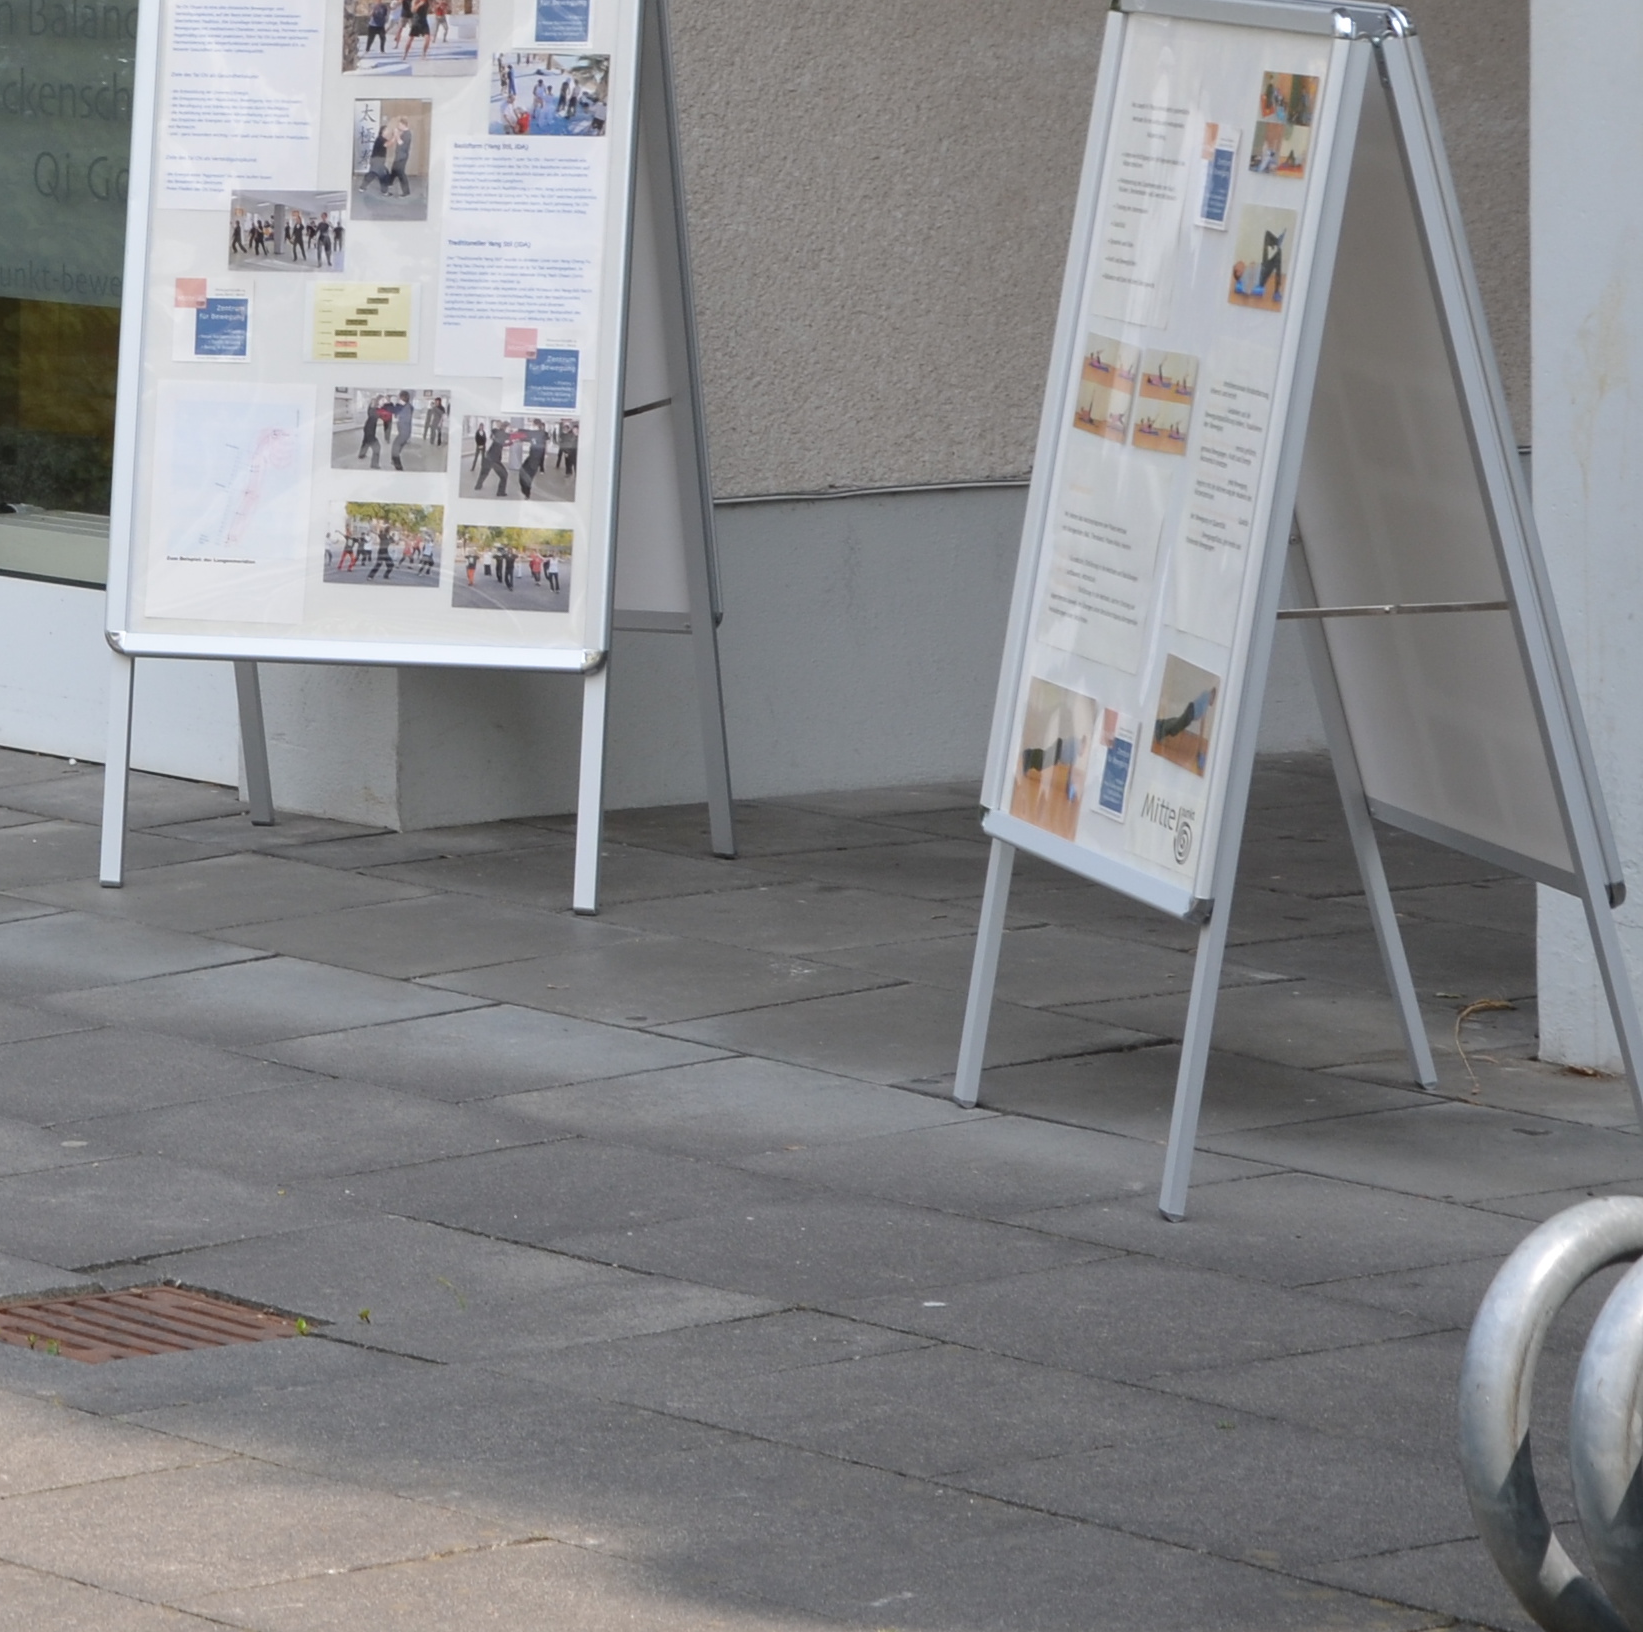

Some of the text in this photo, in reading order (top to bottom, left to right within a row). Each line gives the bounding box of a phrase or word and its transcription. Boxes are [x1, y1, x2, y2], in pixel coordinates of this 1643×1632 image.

[33, 151, 71, 203] Qi
[87, 156, 130, 203] Go
[1140, 792, 1182, 833] Mittel
